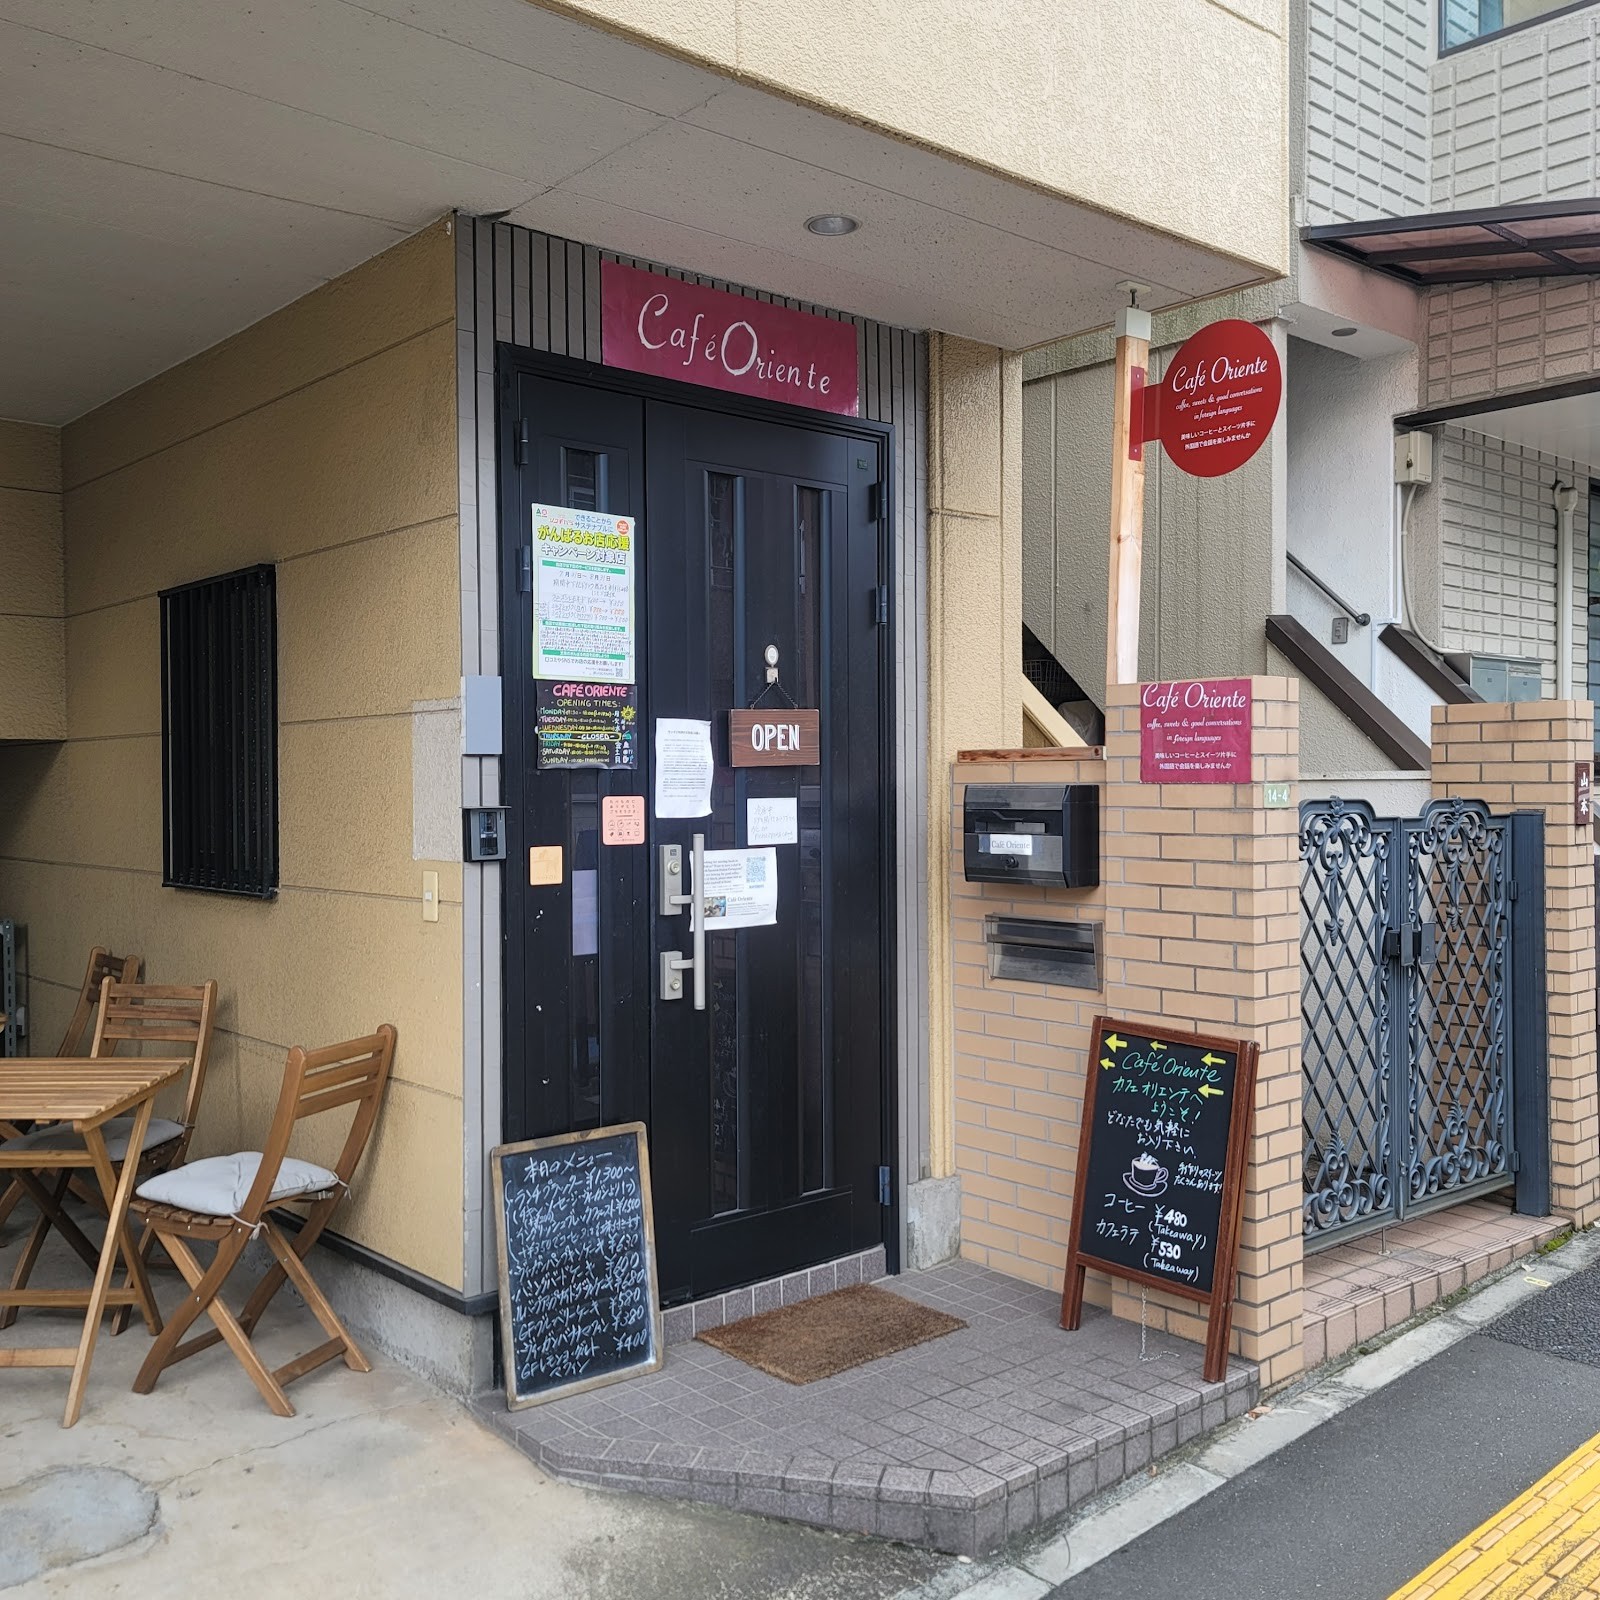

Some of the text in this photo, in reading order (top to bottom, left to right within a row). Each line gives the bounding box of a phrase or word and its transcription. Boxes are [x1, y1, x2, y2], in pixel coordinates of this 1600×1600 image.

[638, 293, 831, 394] Café Oriente
[1172, 356, 1268, 395] Café Oriente
[1192, 397, 1207, 407] sweets
[1208, 394, 1215, 404] &
[1216, 389, 1229, 404] good
[1229, 385, 1263, 400] conversations
[1194, 404, 1243, 422] in foreign languages
[1181, 420, 1256, 441] 美味しいコーヒーとスイーツ片手に
[1184, 432, 1252, 451] 外国語で会話を楽しみませんか
[574, 521, 614, 533] サステナブルに
[575, 514, 613, 526] できることから
[537, 525, 631, 552] がんばるお店応援
[541, 543, 627, 565] キャンペーン対象店
[553, 683, 628, 697] CAFÉ ORIENTE
[1142, 681, 1247, 714] Café Oriente
[540, 706, 566, 716] MONDAY
[556, 698, 621, 708] OPENING TIMES:
[540, 715, 567, 723] TUESDAY
[1146, 717, 1242, 730] coffee, sweets & good conversations
[751, 724, 800, 751] OPEN
[1166, 732, 1222, 744] in foreign languages
[541, 747, 571, 756] SATURDAY
[541, 756, 569, 764] SUNDAY
[1154, 751, 1237, 760] 美味しいコーヒーとスイーツ片手に
[1159, 762, 1232, 770] 外国語で会話を楽しみませんか
[1267, 788, 1289, 803] 14-4
[991, 840, 1031, 849] Café Oriente
[1122, 1051, 1221, 1082] Café Oriente
[1107, 1110, 1190, 1138] どなたでも気軽に
[523, 1152, 613, 1183] 本日のメニュー
[1104, 1193, 1188, 1227] コーヒー ¥480
[1096, 1218, 1139, 1245] カフェラテ
[1148, 1220, 1207, 1251] (Takeaway)
[608, 1233, 639, 1254] ¥630
[1151, 1234, 1182, 1259] ¥530
[604, 1253, 640, 1279] ¥600
[1143, 1253, 1200, 1283] (Takeaway)
[614, 1267, 646, 1293] ¥680
[608, 1286, 642, 1314] ¥580
[611, 1305, 645, 1331] ¥380
[612, 1328, 647, 1356] ¥400
[550, 1358, 591, 1378] マフィン
